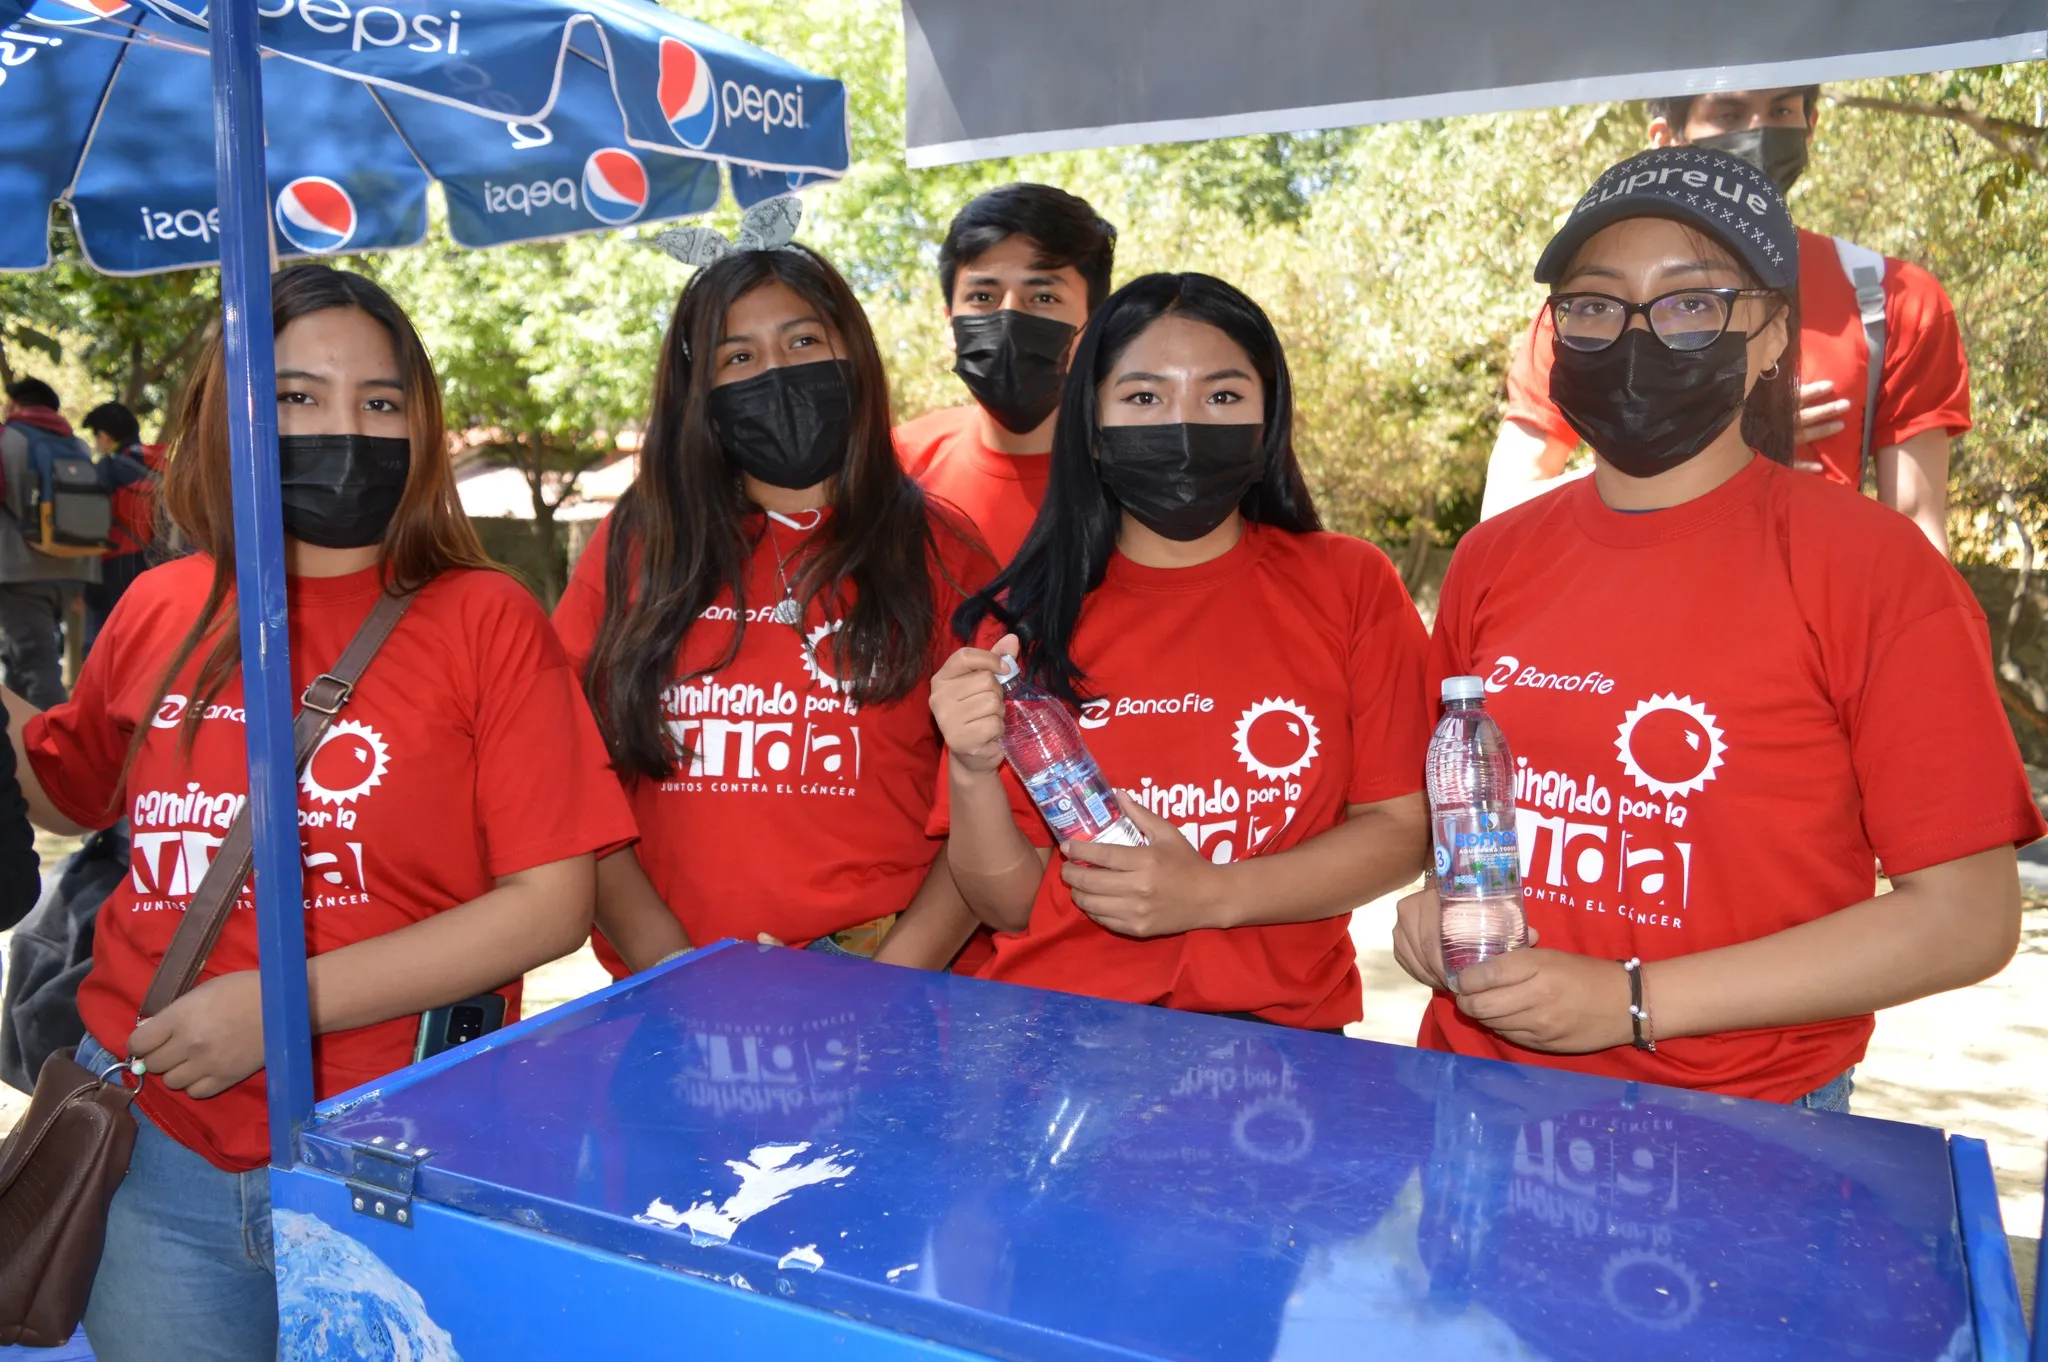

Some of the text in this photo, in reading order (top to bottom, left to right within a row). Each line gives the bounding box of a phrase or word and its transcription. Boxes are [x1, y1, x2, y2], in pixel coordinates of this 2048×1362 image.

[722, 80, 804, 134] pepsi
[660, 675, 798, 717] aminando
[803, 695, 841, 718] por
[661, 782, 856, 797] JUNTOS CONTRA EL CÁNCER
[1246, 787, 1281, 812] por
[1284, 781, 1302, 801] la
[1514, 756, 1688, 828] inando por la
[336, 806, 357, 831] la
[302, 892, 370, 911] CÁNCER
[1523, 886, 1682, 929] ONTRA EL CÁNCER
